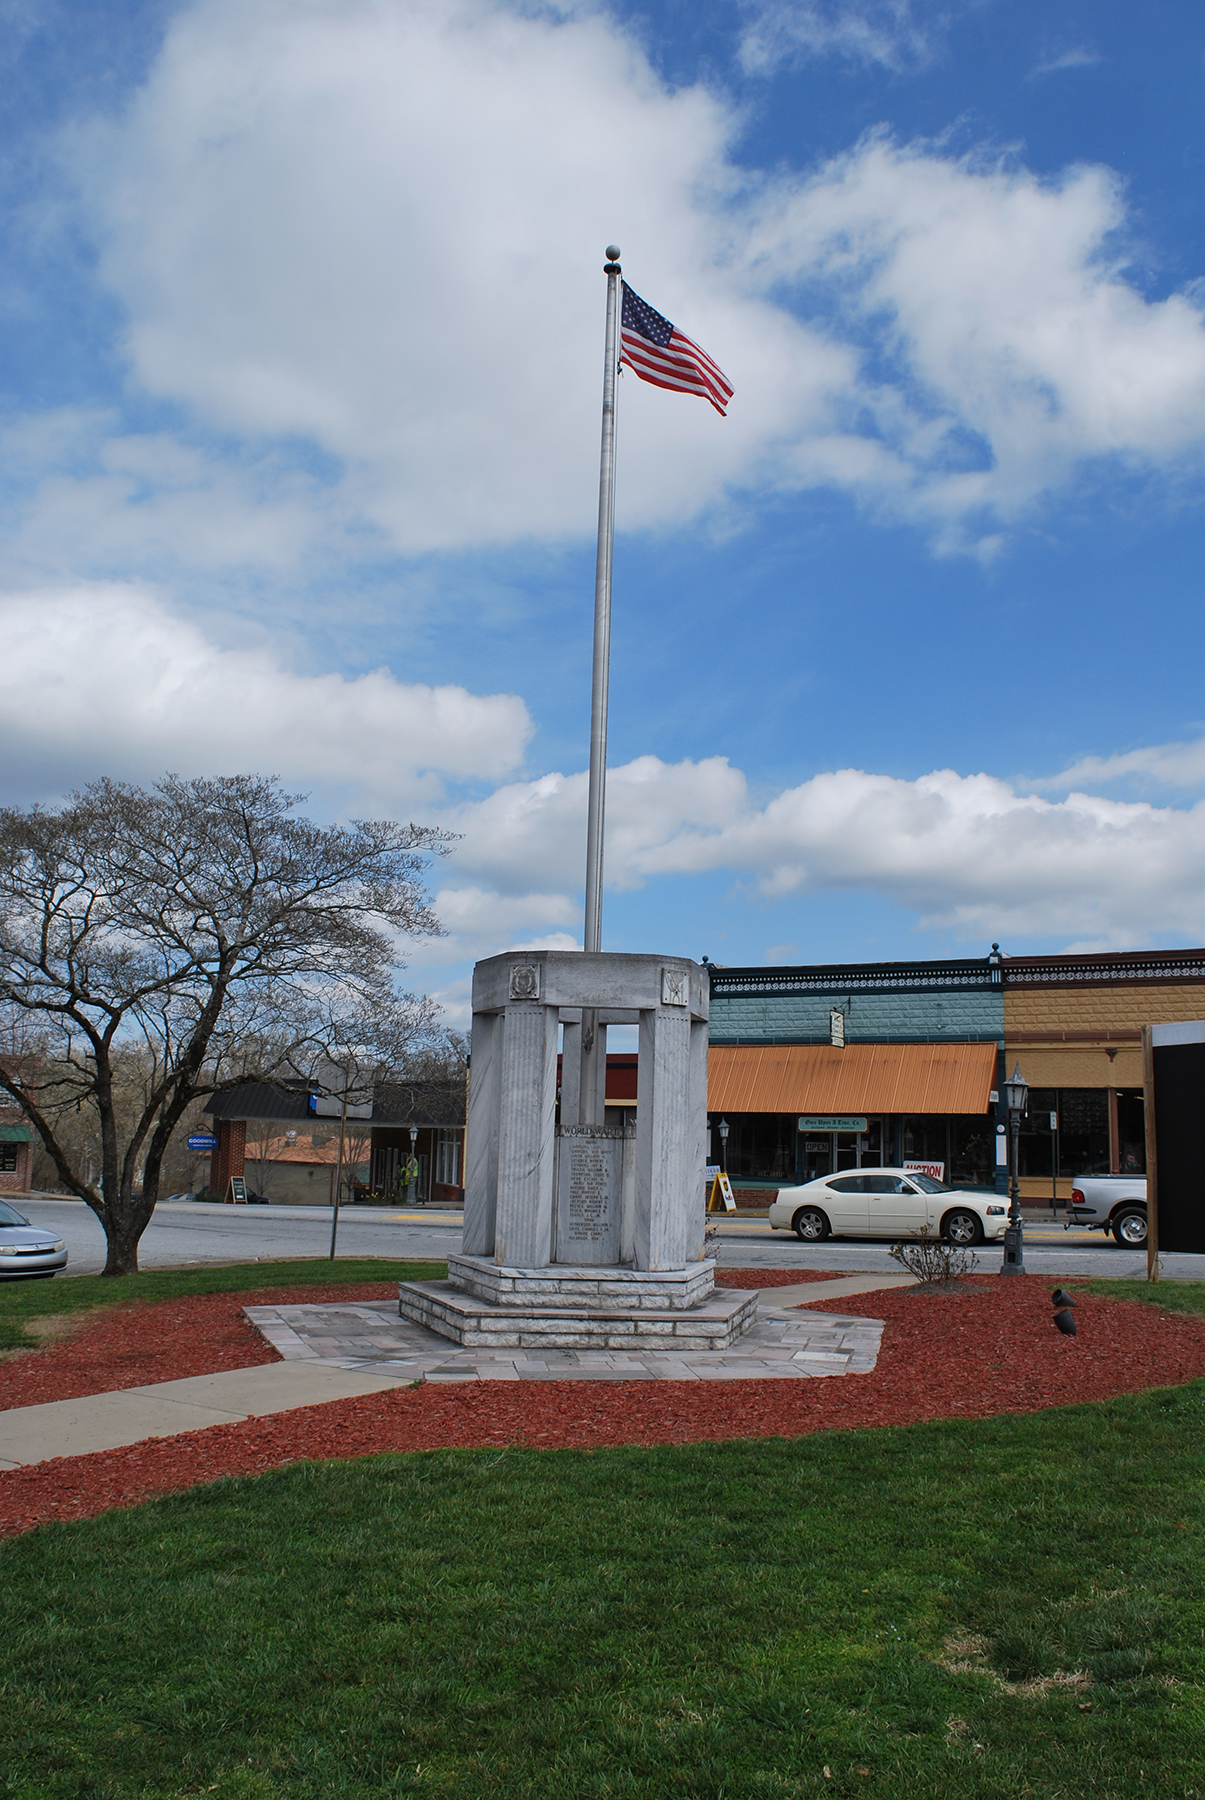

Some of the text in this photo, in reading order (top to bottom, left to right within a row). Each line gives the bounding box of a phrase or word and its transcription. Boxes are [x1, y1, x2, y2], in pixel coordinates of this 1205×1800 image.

[564, 1127, 592, 1135] WORLD
[594, 1128, 612, 1136] WAR
[806, 1143, 828, 1151] OPEN
